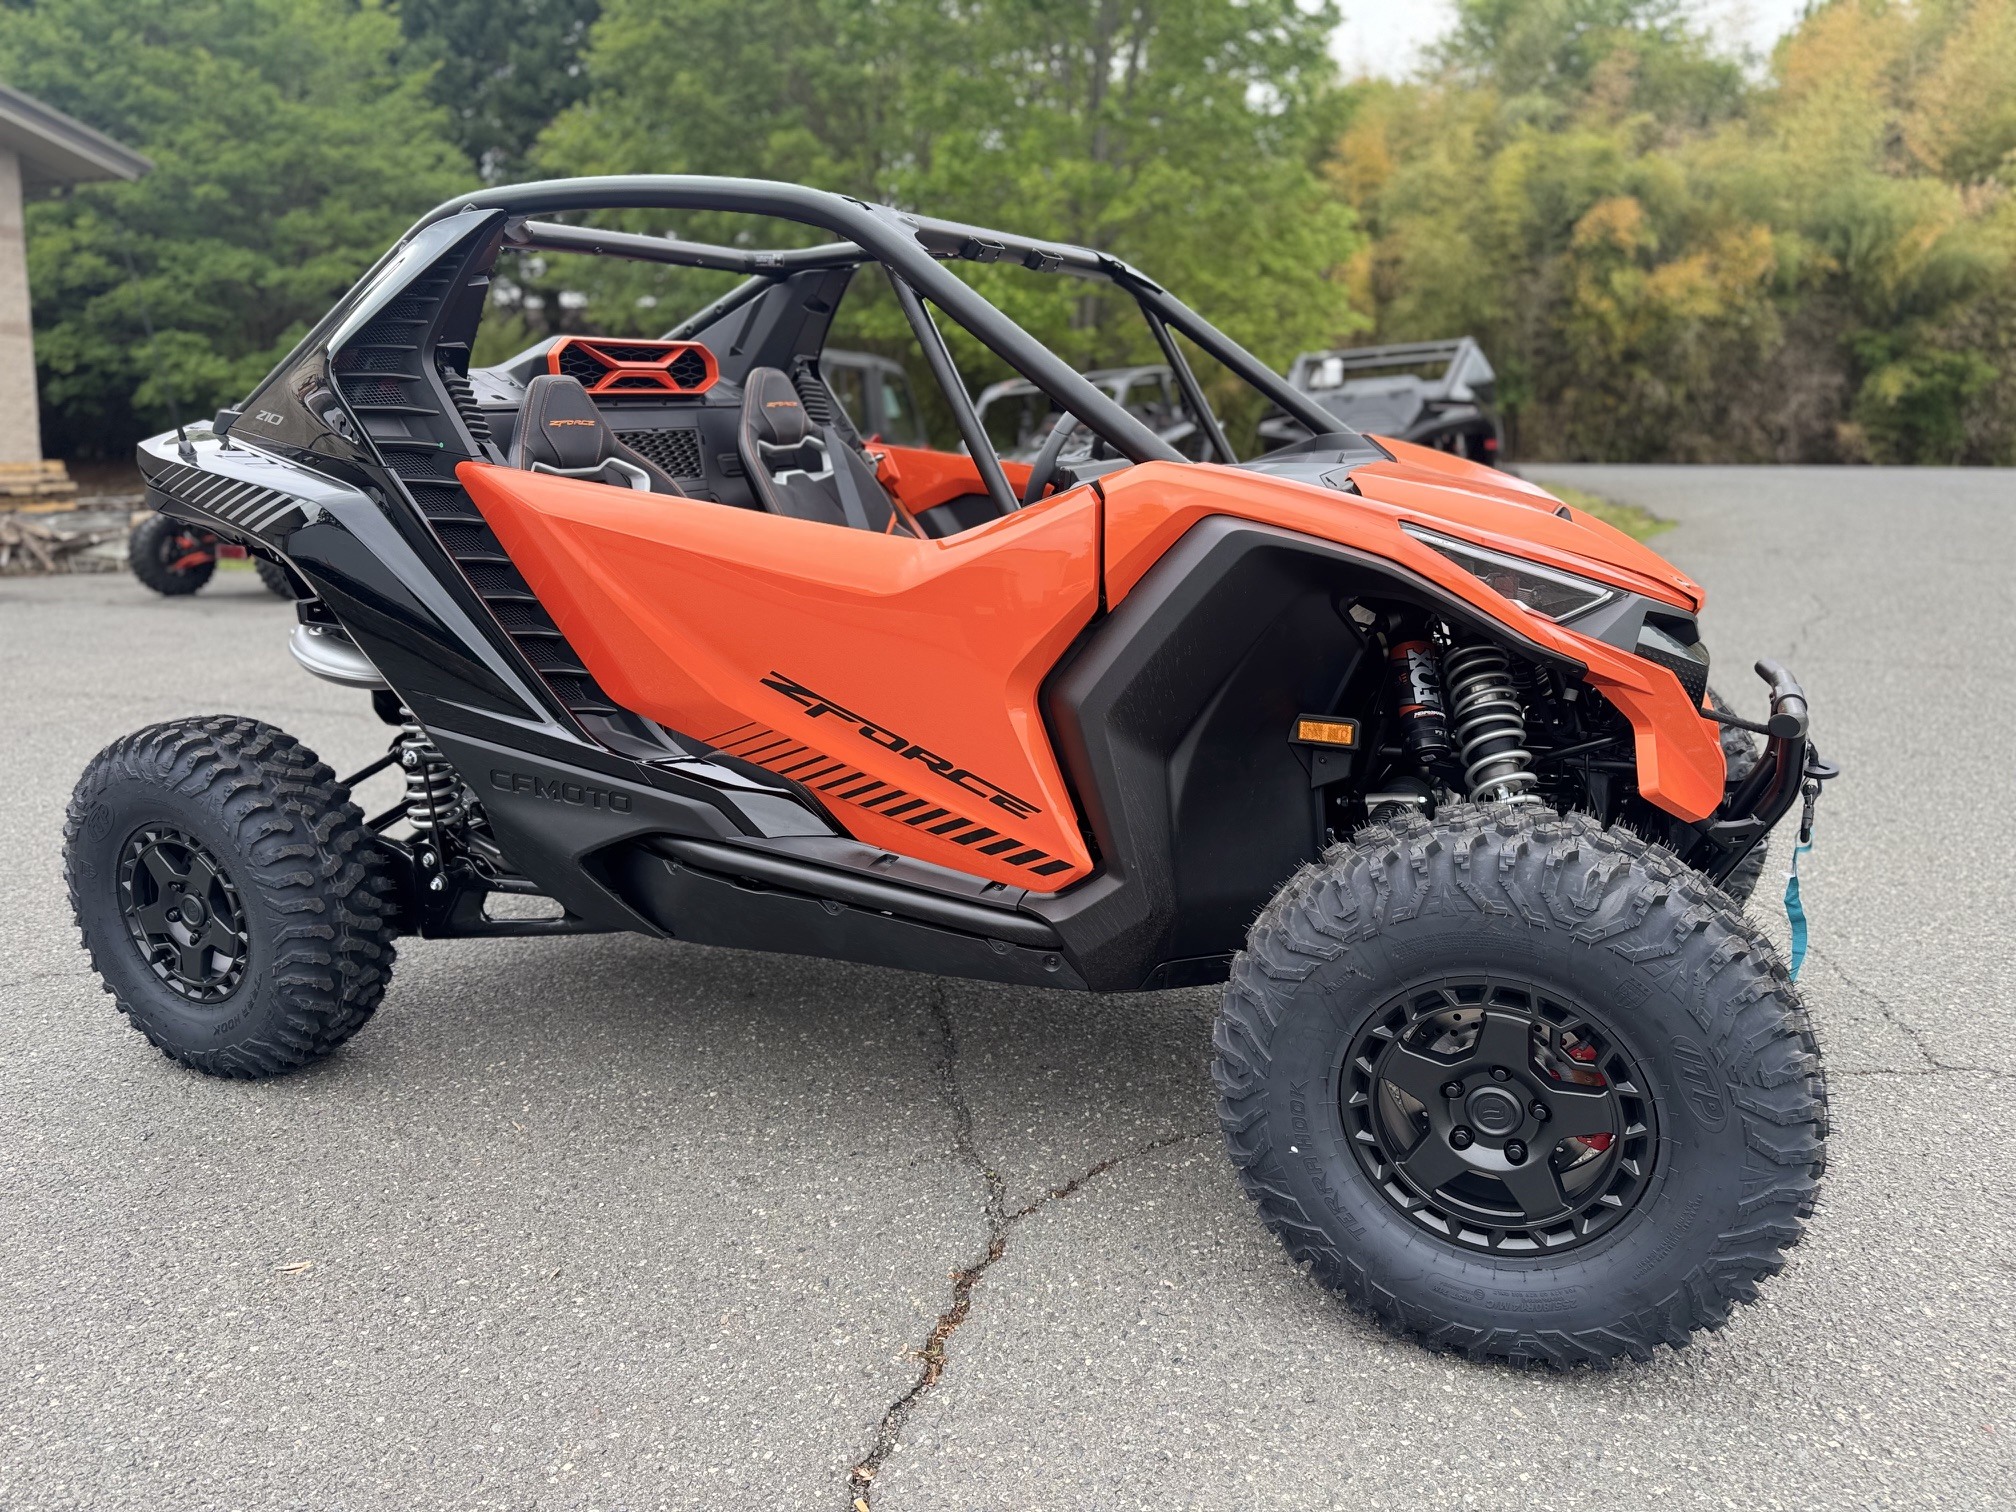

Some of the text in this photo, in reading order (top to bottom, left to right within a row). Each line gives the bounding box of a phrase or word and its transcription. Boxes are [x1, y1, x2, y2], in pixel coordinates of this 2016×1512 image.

[550, 419, 596, 428] ZFORCE
[1407, 648, 1440, 704] FOX
[759, 670, 1043, 820] ZFORCE
[490, 768, 634, 815] CFMOTO
[1673, 1045, 1725, 1120] ITP
[1290, 1080, 1314, 1150] HOOK
